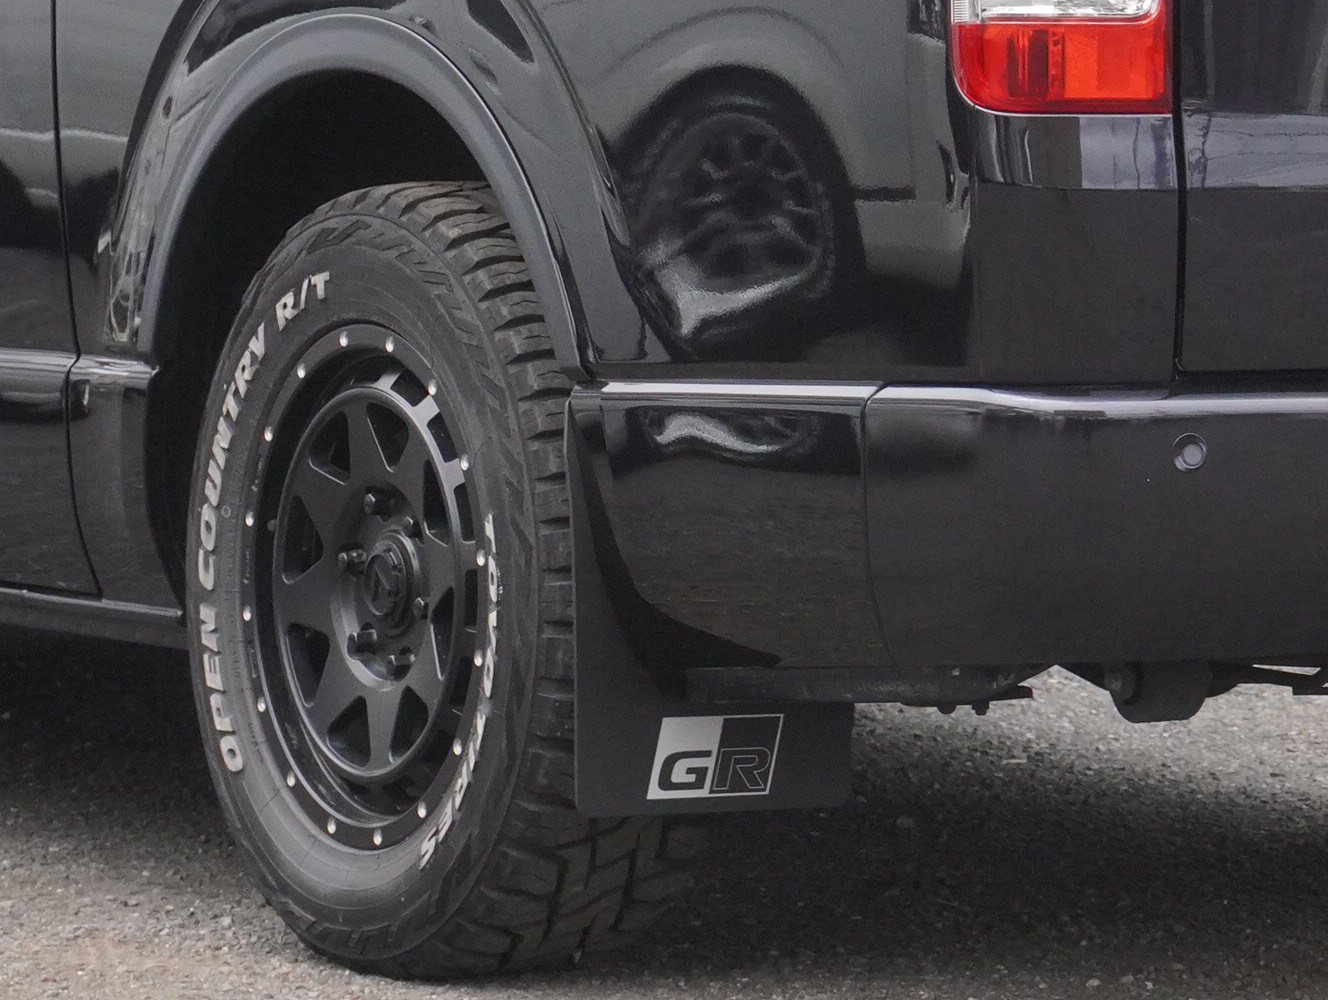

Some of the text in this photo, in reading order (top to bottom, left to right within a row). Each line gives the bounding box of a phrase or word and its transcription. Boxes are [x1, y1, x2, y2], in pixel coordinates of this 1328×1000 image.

[275, 271, 331, 332] R/T
[198, 321, 266, 582] COUNTRY
[199, 602, 244, 773] OPEN
[657, 747, 772, 792] GR
